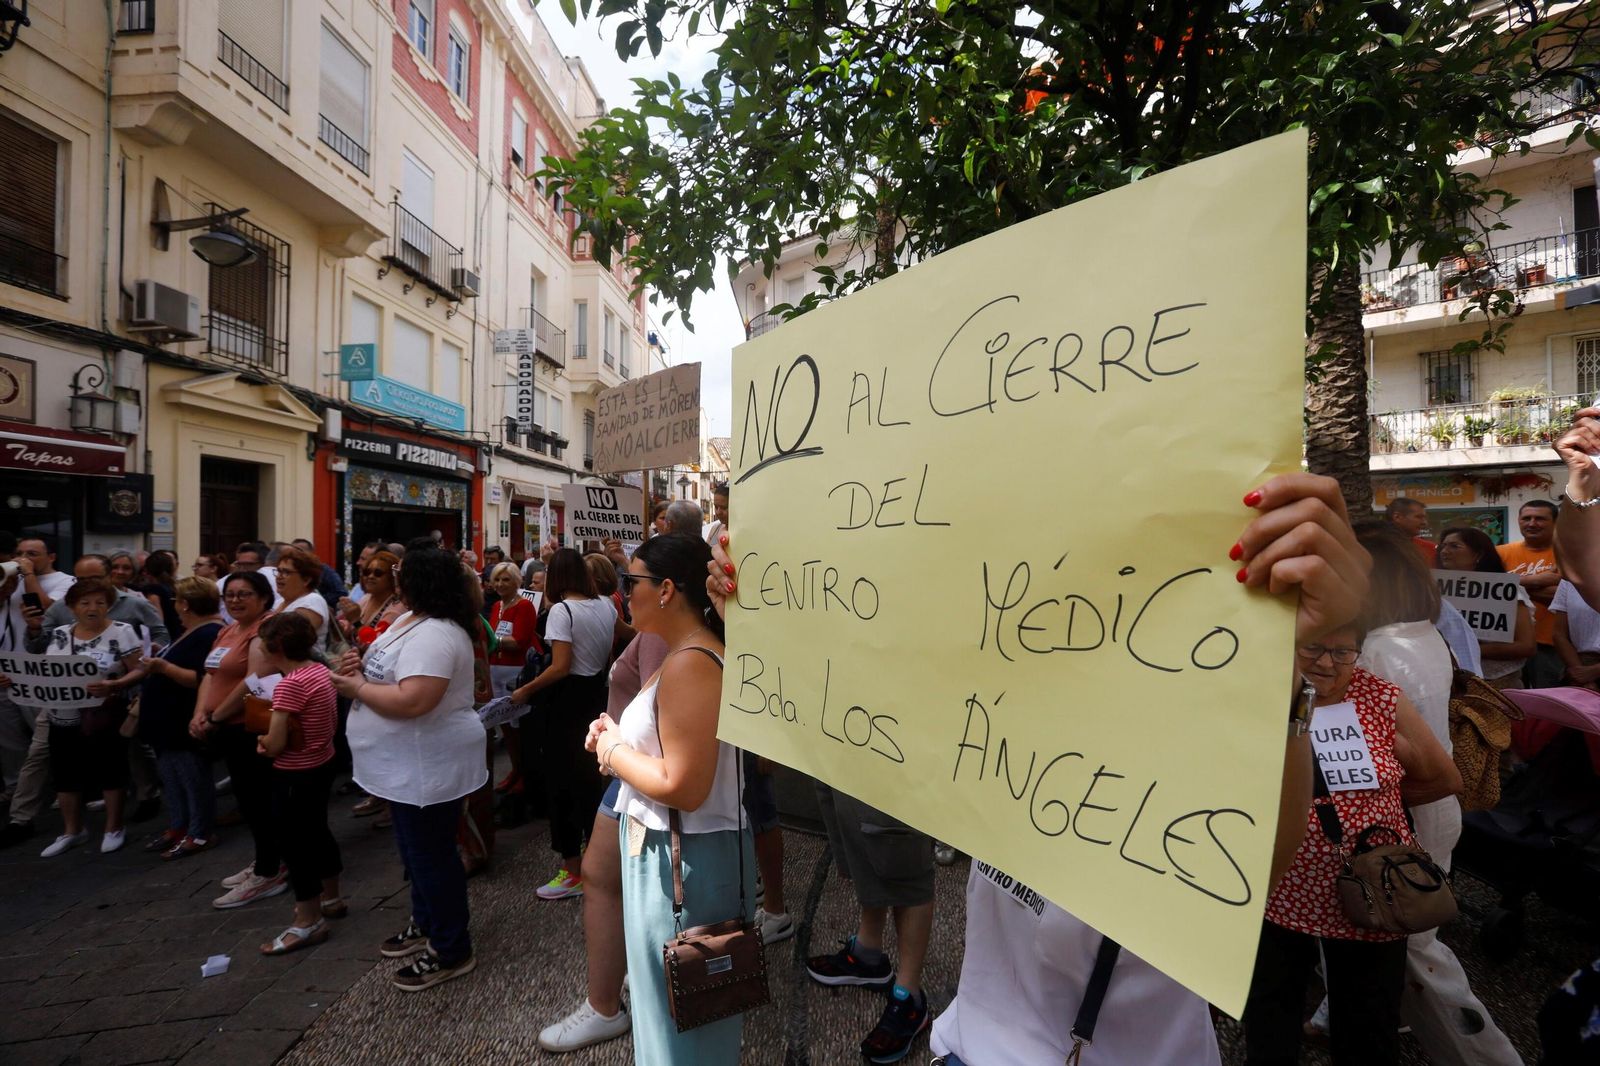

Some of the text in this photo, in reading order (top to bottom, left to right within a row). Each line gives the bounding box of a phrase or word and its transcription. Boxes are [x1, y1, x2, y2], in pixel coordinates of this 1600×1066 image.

[518, 354, 532, 423] ABOGADOS
[598, 375, 679, 418] ESTA ES LA
[596, 411, 639, 439] SANIDAD
[641, 404, 656, 420] DE
[737, 353, 822, 471] NO
[846, 365, 911, 435] AL
[5, 443, 76, 467] Tapas
[344, 437, 392, 455] PIZZERIA
[396, 442, 458, 471] PIZZAIOLO
[588, 488, 616, 510] NO
[827, 463, 951, 530] DEL
[573, 510, 643, 526] AL CIERRE DEL
[612, 526, 644, 542] MÉDIC
[734, 552, 880, 620] CENTRO
[1437, 576, 1518, 602] MÉDICO
[1461, 609, 1509, 632] EDA
[0, 658, 21, 674] EL
[24, 659, 98, 678] MÉDICO
[10, 682, 31, 699] SE
[1309, 725, 1361, 744] URA
[1317, 749, 1364, 763] ALUD
[820, 658, 905, 764] LOS
[952, 690, 1257, 907] ÁNGELES
[1324, 767, 1374, 786] ELES
